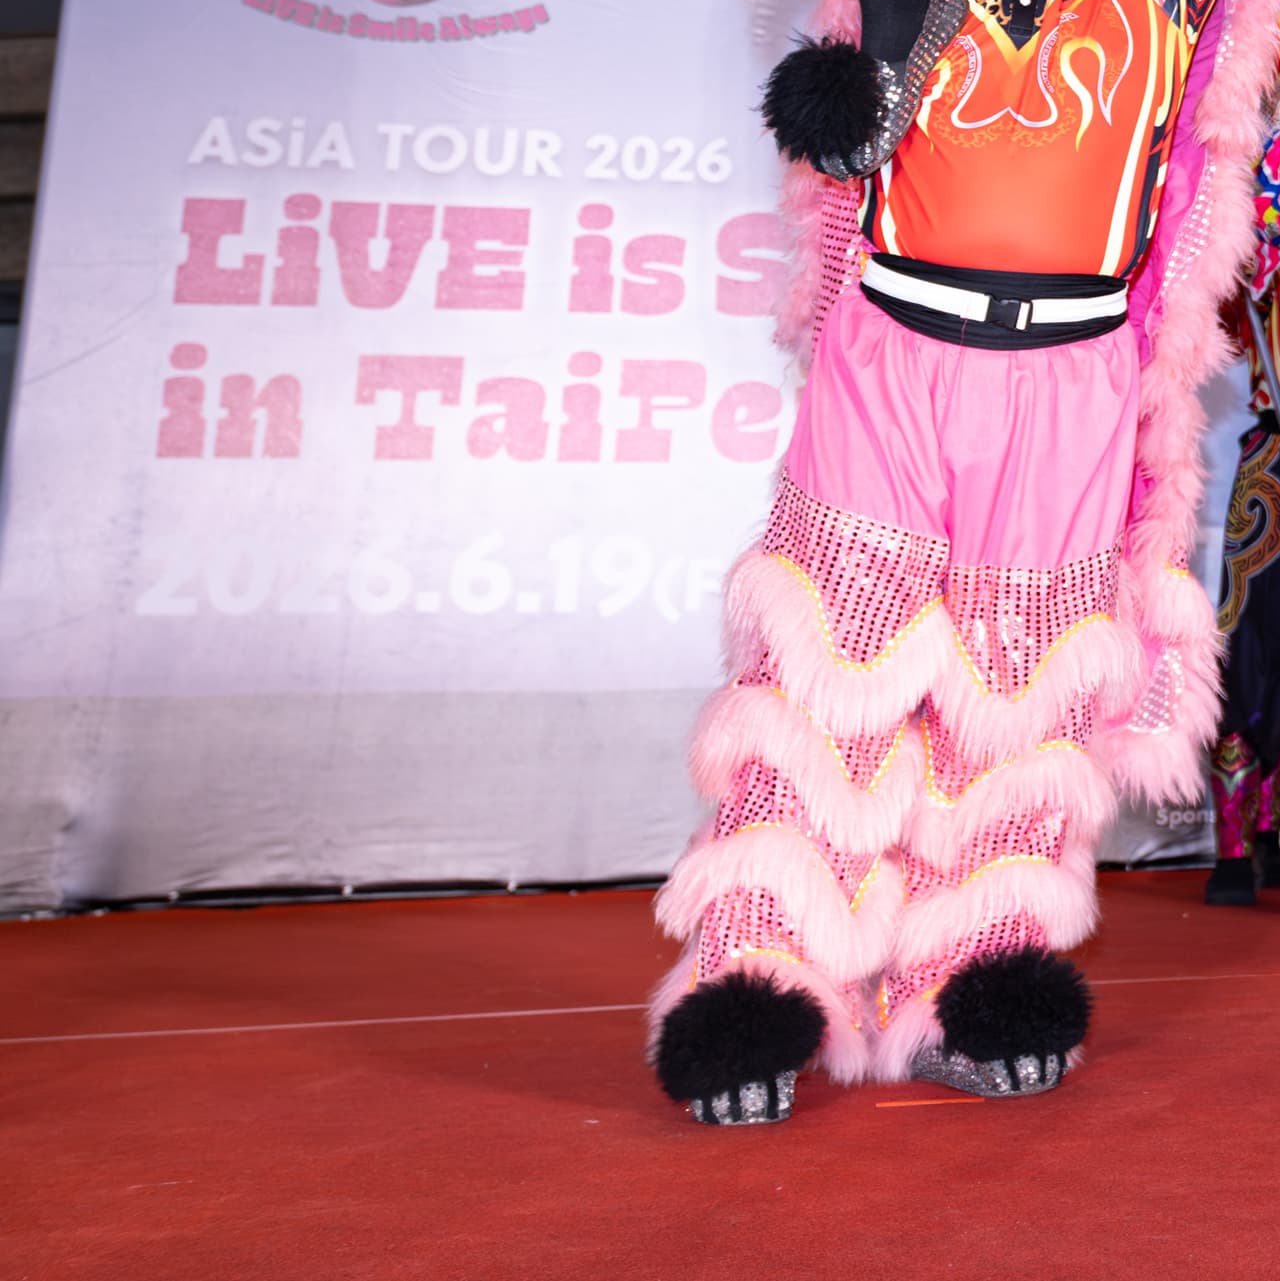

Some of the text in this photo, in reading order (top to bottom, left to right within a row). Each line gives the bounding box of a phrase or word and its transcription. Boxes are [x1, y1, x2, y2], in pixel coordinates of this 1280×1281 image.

[187, 115, 734, 184] ASiA TOUR 2026
[172, 192, 532, 312] LiVE
[567, 202, 688, 318] is
[155, 342, 783, 464] in TaiPe
